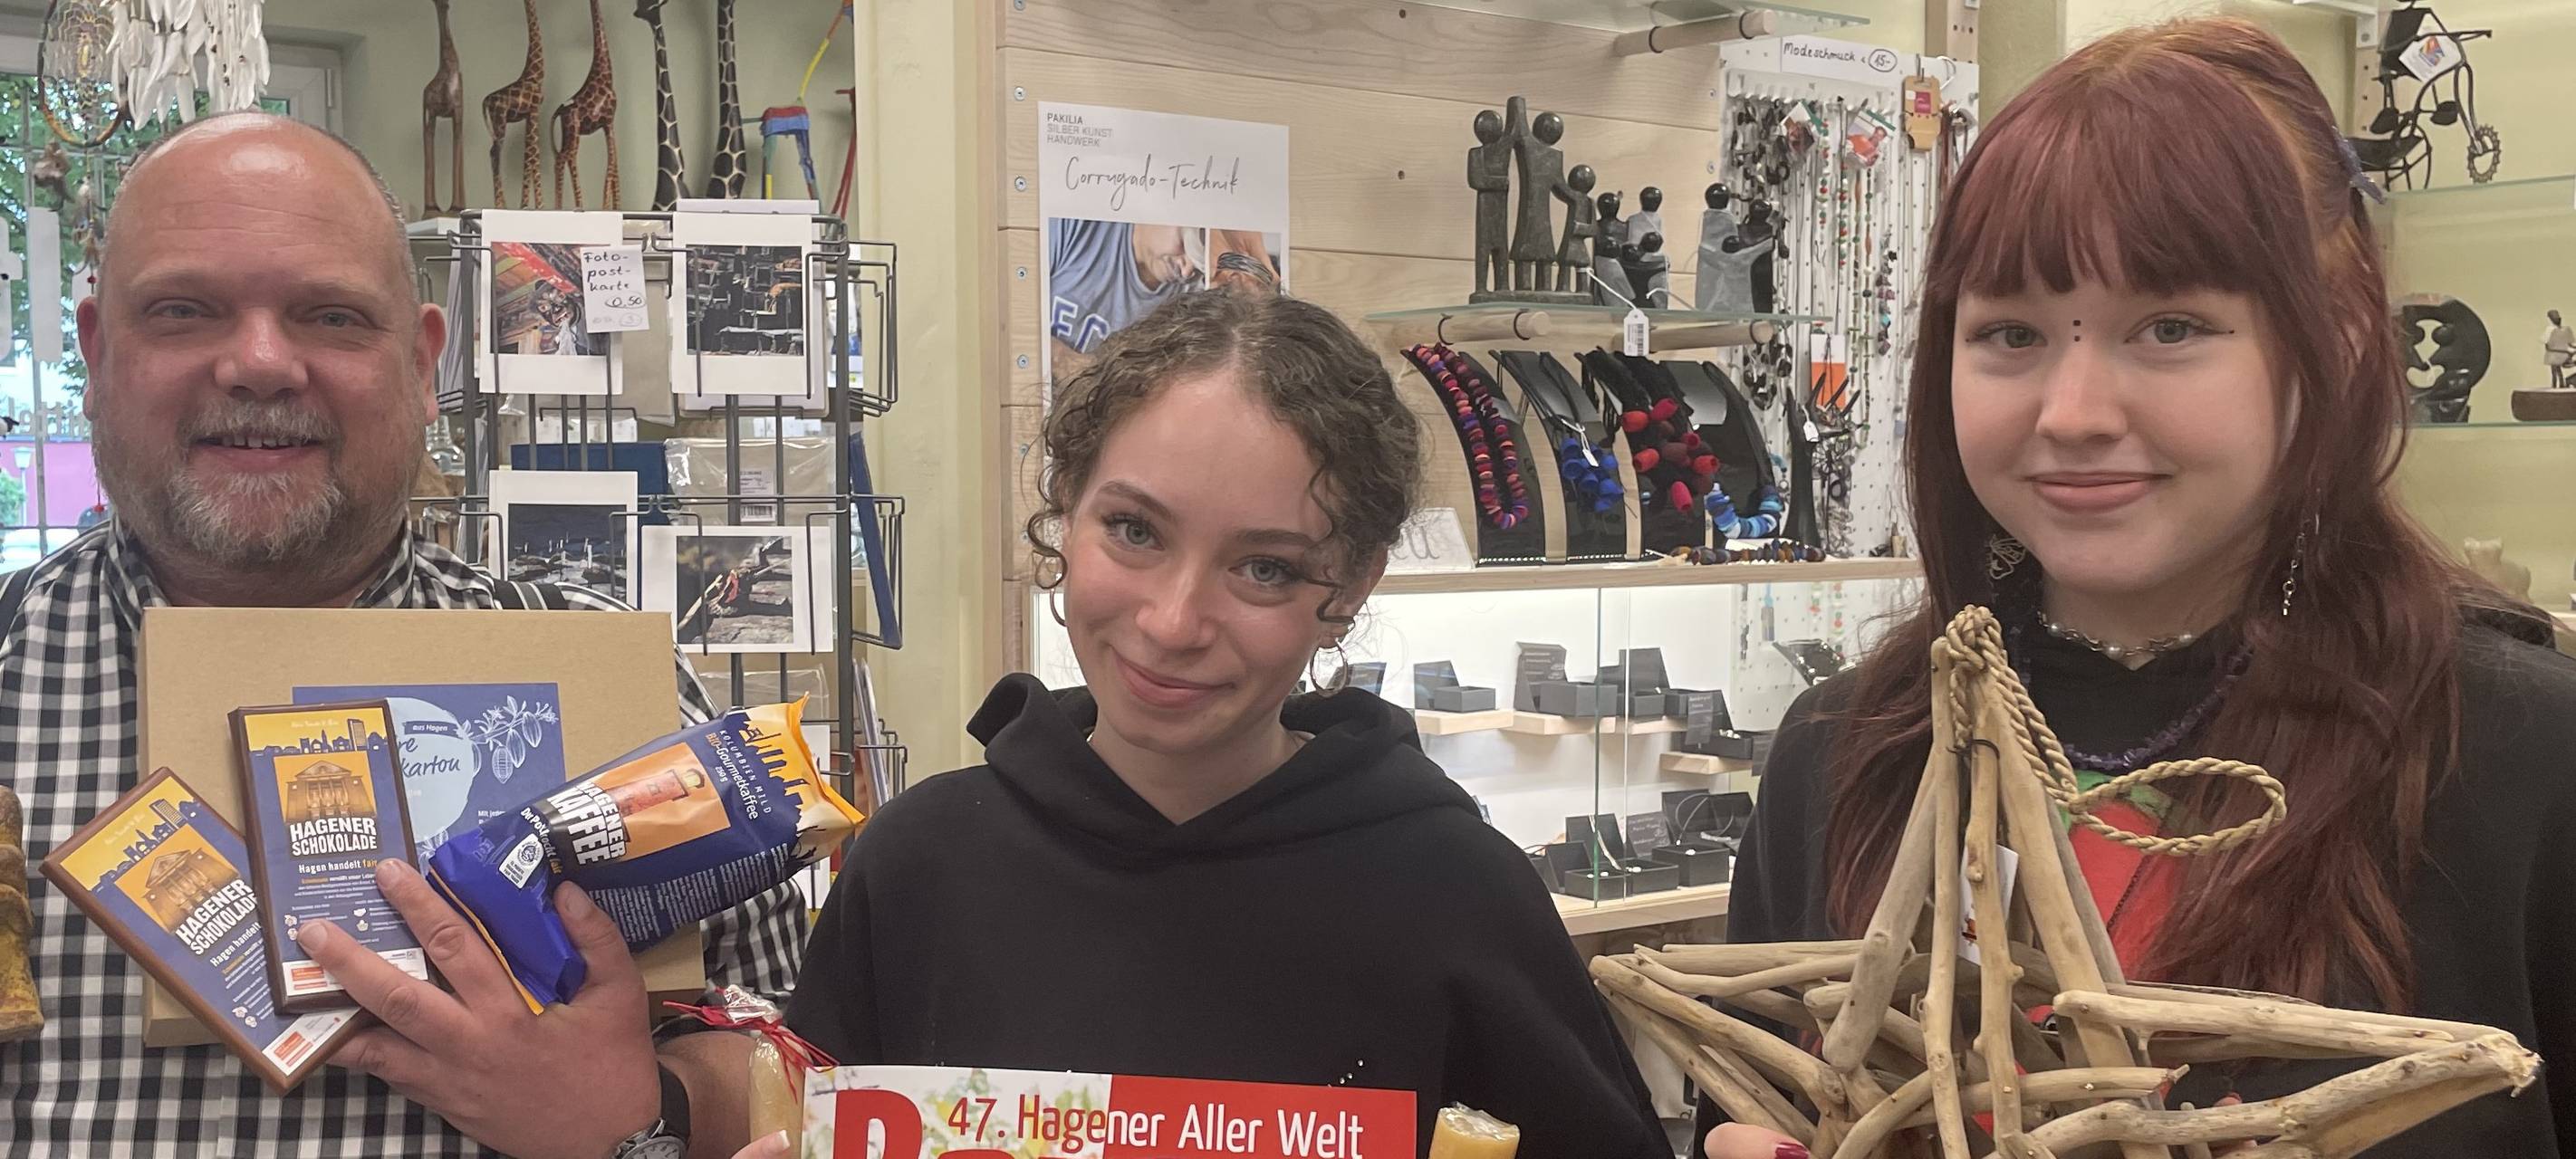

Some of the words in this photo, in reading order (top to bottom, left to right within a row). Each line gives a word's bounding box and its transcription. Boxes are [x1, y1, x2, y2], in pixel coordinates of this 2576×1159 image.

[1783, 43, 1856, 62] Modeschmuck
[1047, 112, 1083, 125] PAKILIA
[1047, 123, 1080, 135] SILBER
[1081, 127, 1113, 138] KUNST
[1047, 135, 1101, 147] HANDWERK
[1065, 153, 1240, 212] Corrugado-Technik
[705, 732, 759, 820] BIO-Gourmetkaffee
[718, 729, 757, 781] KOLUMBIEN
[755, 785, 772, 814] MILD
[290, 817, 377, 843] HAGENER
[546, 786, 611, 866] KAFFEE
[576, 780, 628, 858] HAGENER
[292, 833, 378, 857] SCHOKOLADE
[298, 863, 327, 875] Hagen
[327, 859, 362, 871] handelt
[175, 878, 254, 946] HAGENER
[209, 944, 236, 967] Hagen
[947, 1097, 1006, 1142] 47.
[1017, 1094, 1165, 1154] Hagener
[1177, 1103, 1264, 1153] Aller
[1277, 1108, 1364, 1159] Welt
